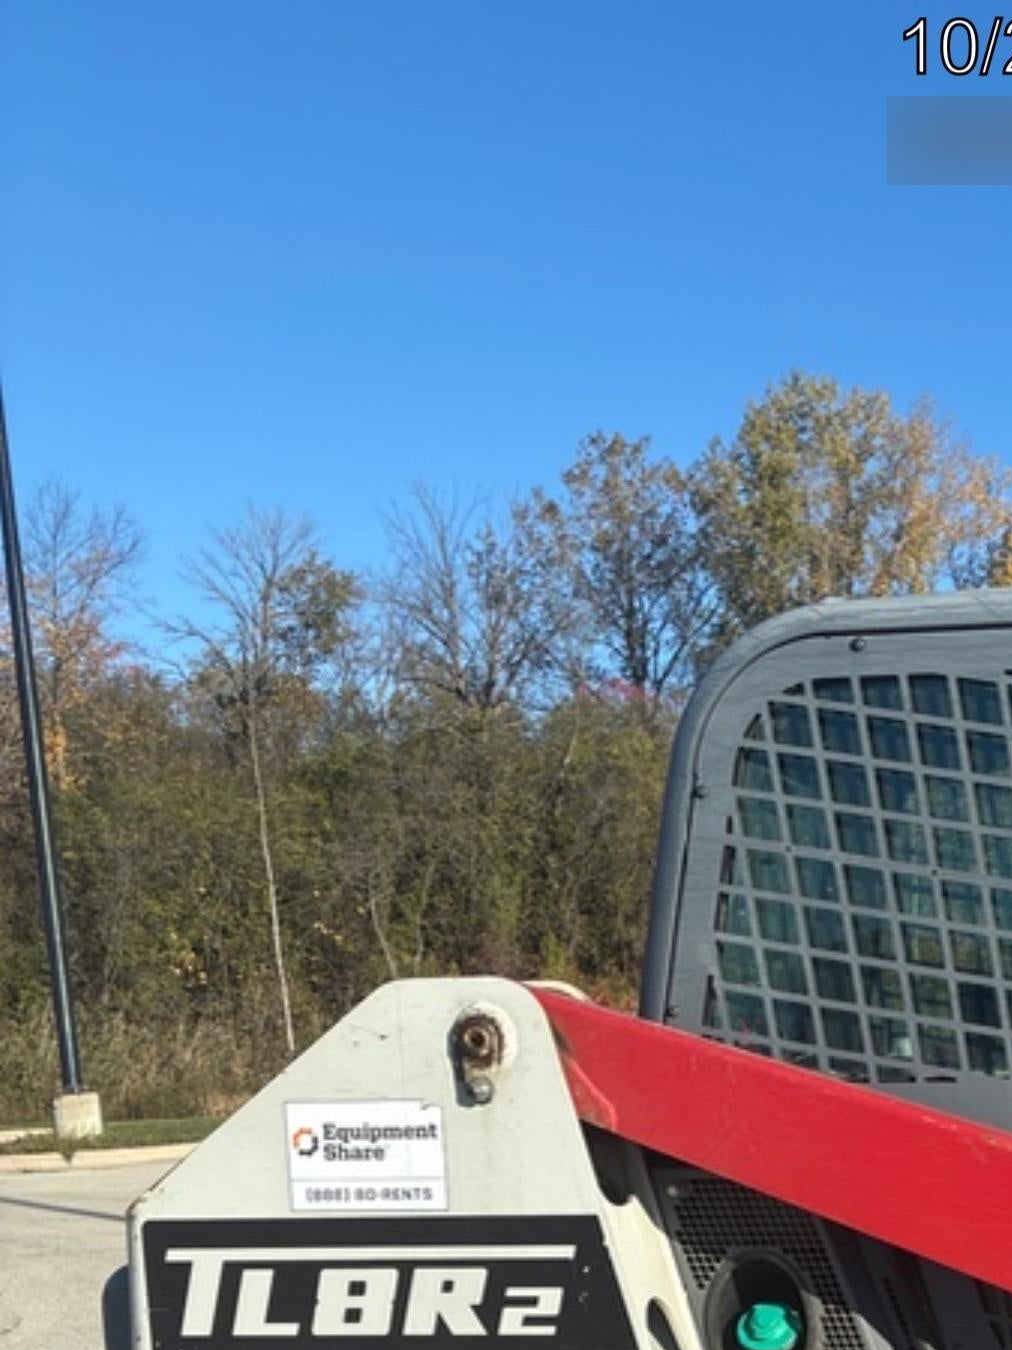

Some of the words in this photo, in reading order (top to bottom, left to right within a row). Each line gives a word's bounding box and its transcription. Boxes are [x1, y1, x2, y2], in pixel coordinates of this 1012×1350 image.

[322, 1122, 438, 1143] Equipment
[322, 1144, 385, 1162] Share
[164, 1244, 577, 1337] TL8R2
